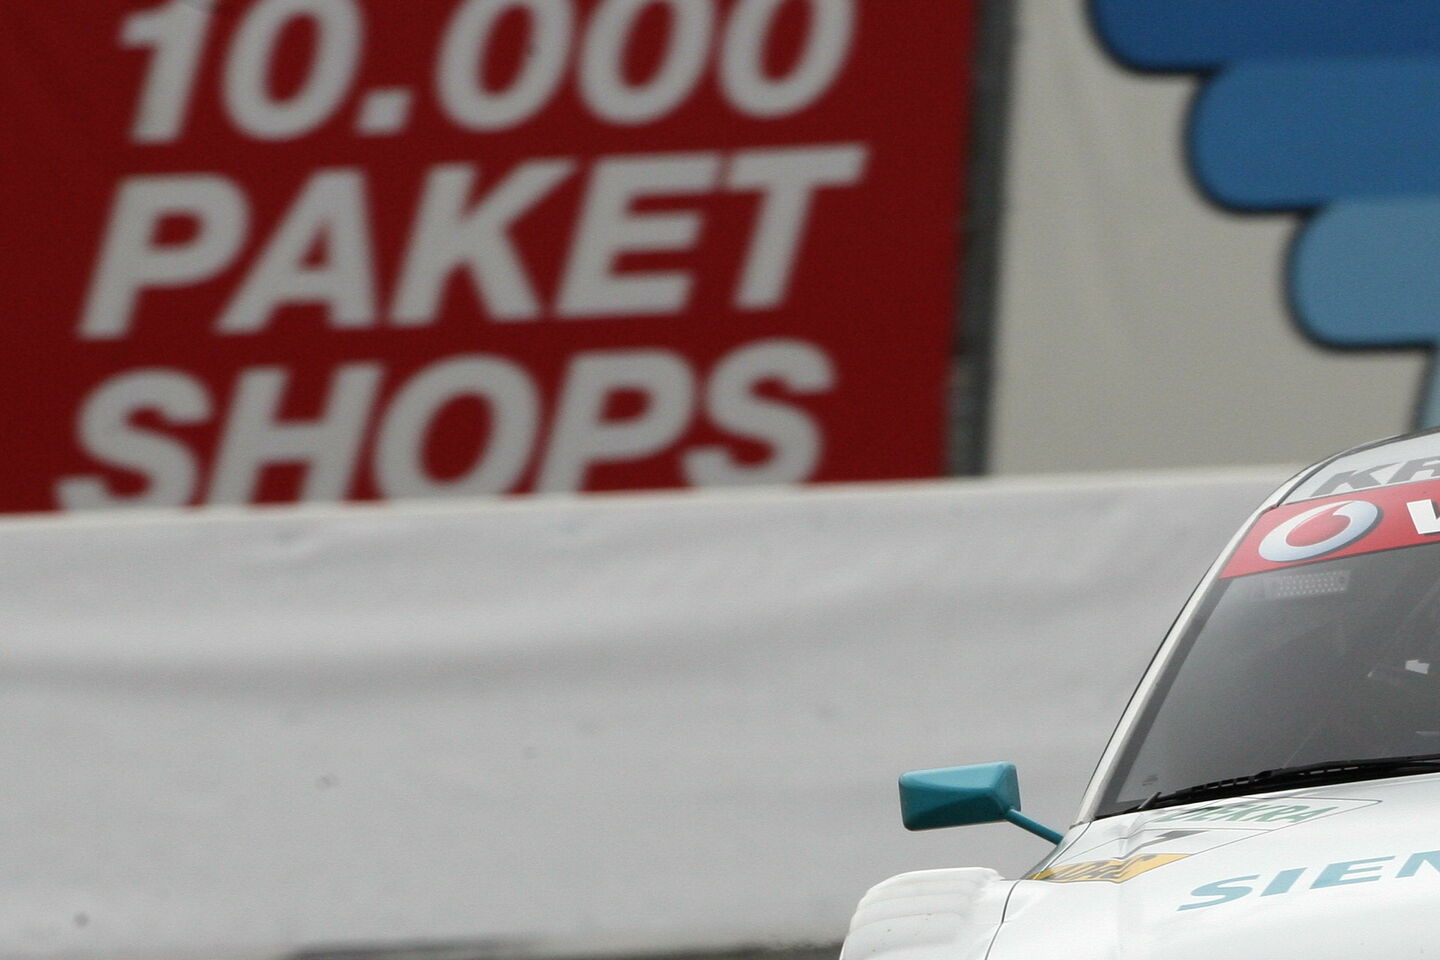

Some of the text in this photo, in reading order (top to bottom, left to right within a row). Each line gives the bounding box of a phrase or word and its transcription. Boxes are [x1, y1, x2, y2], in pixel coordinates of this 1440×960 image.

[118, 0, 860, 143] 10.000
[76, 144, 869, 339] PAKET
[53, 338, 837, 512] SHOPS
